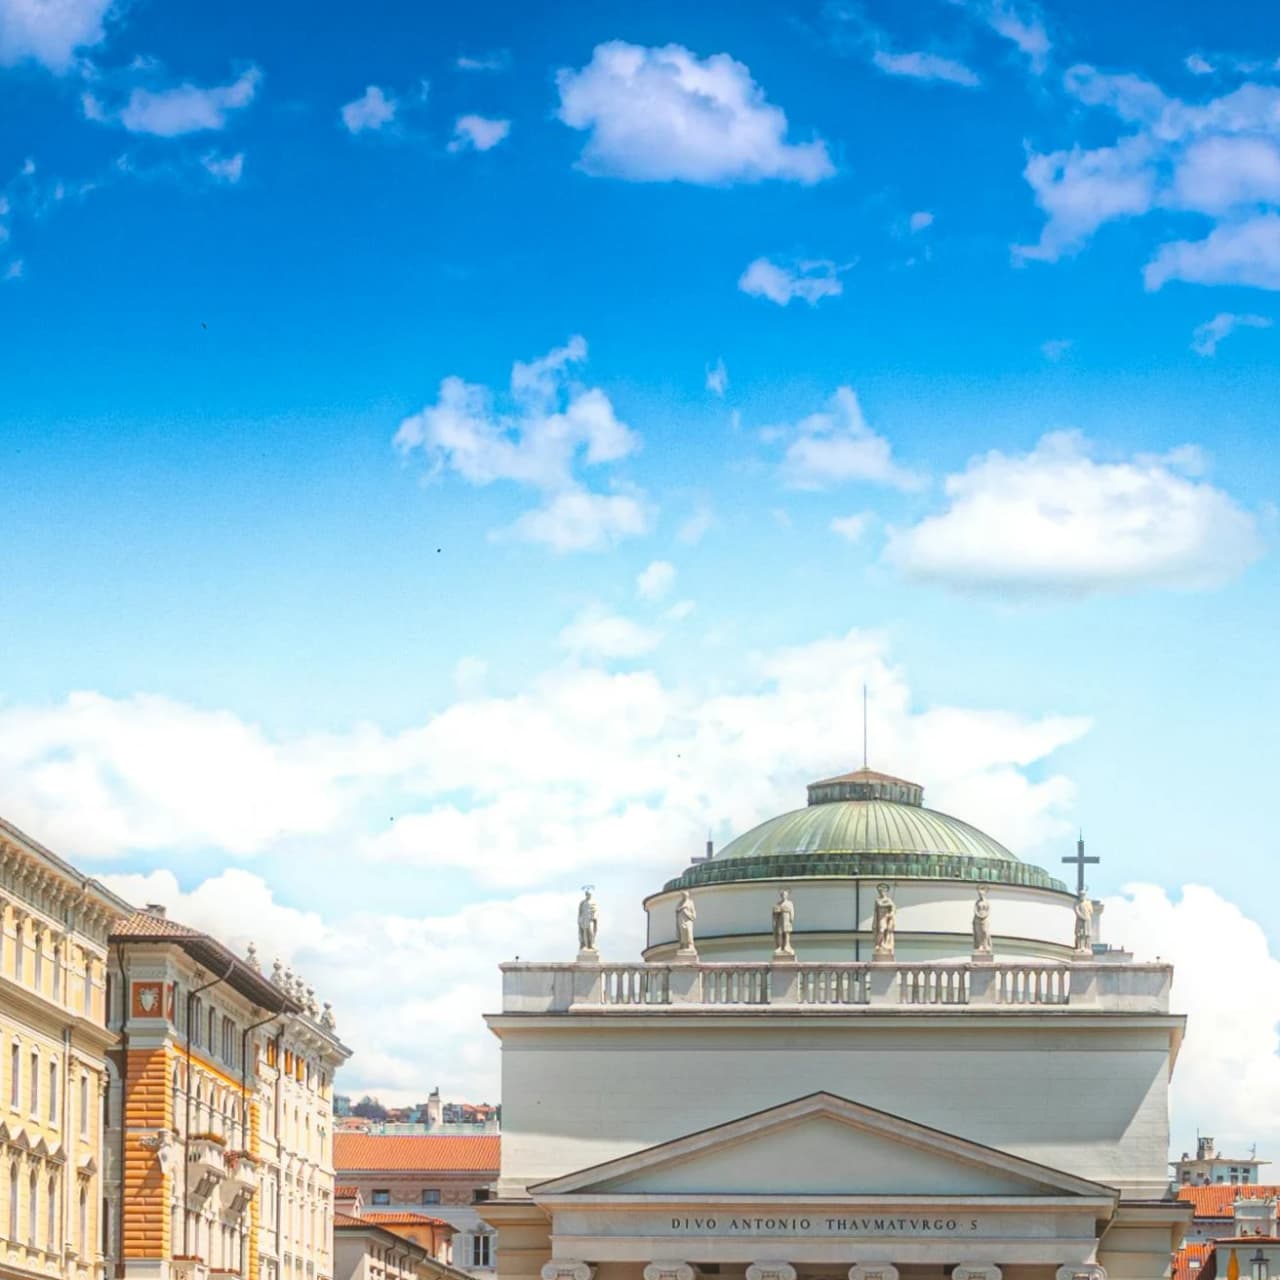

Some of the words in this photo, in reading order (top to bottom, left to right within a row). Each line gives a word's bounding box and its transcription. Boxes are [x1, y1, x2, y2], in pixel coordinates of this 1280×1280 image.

[671, 1218, 717, 1230] DIVO
[729, 1218, 811, 1230] ANTONIO
[825, 1218, 957, 1231] THAVMATVRGO
